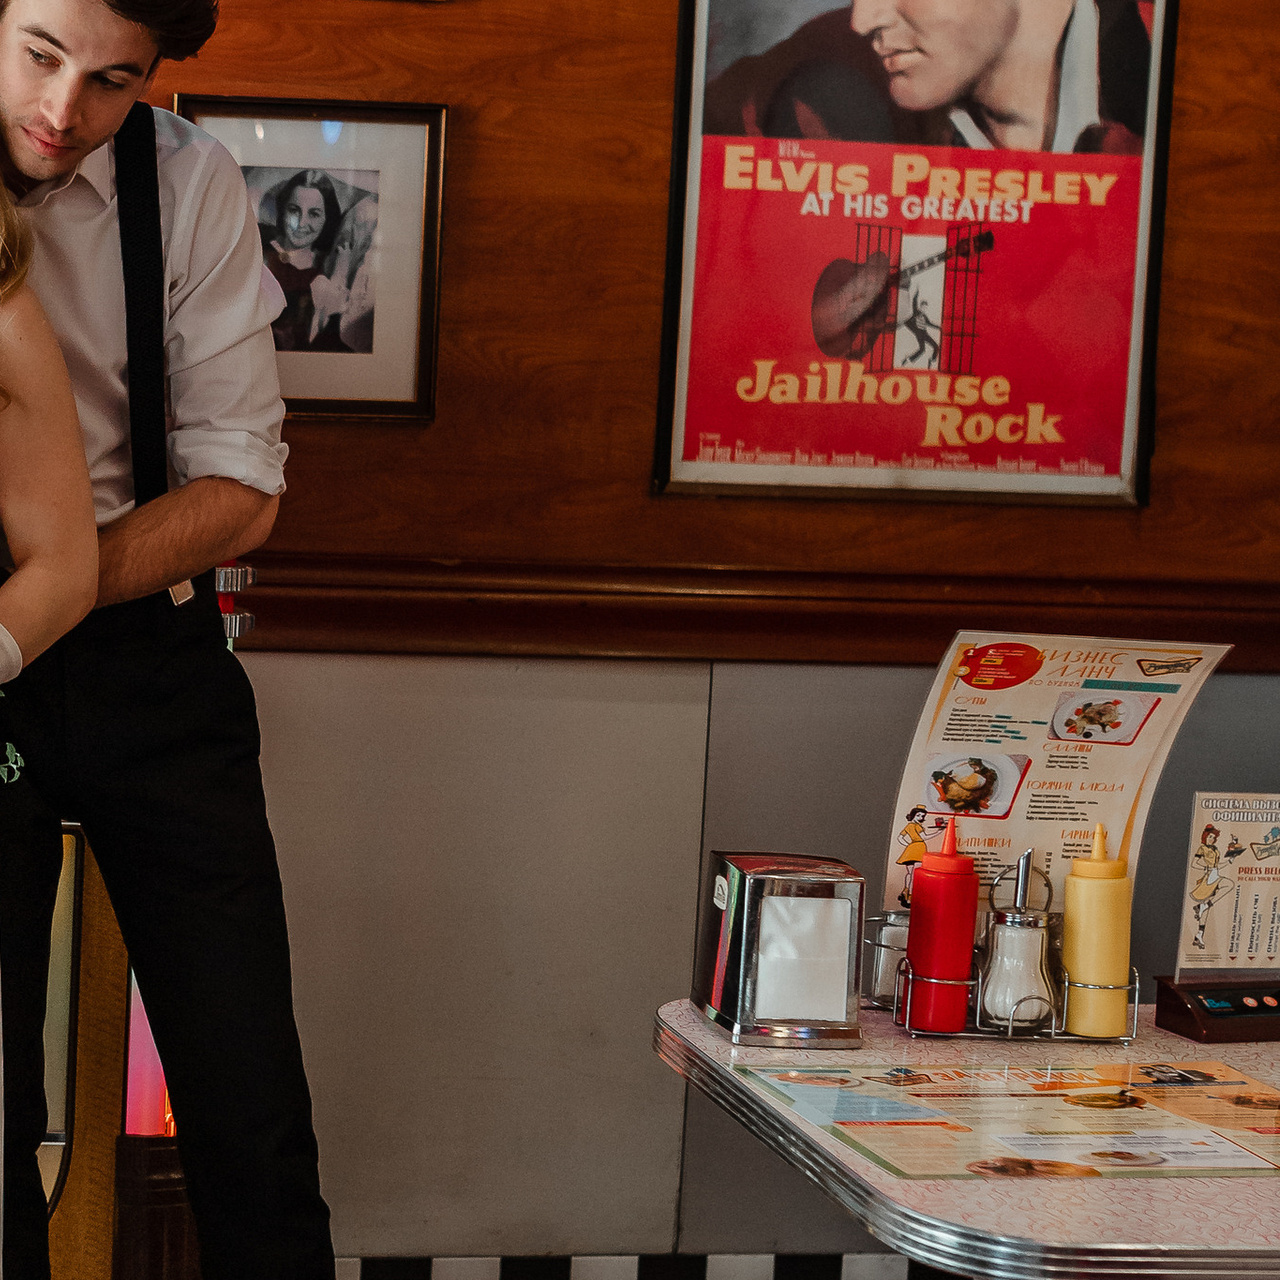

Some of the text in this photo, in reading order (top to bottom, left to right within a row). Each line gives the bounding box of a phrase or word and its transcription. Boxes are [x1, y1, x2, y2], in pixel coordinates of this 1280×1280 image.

[723, 144, 1119, 207] ELVIS PRESLEY
[800, 191, 1034, 224] AT HIS GREATEST
[736, 359, 1011, 406] Jailhouse
[921, 402, 1065, 447] Rock
[1036, 648, 1130, 665] БИЗНЕС
[1046, 664, 1117, 679] ЛАНЧ
[954, 695, 988, 705] СУПЫ
[1026, 780, 1125, 792] ГОРЯЧИЕ БЛЮДА
[1201, 798, 1251, 810] СИСТЕМА
[1238, 867, 1262, 875] PRESS
